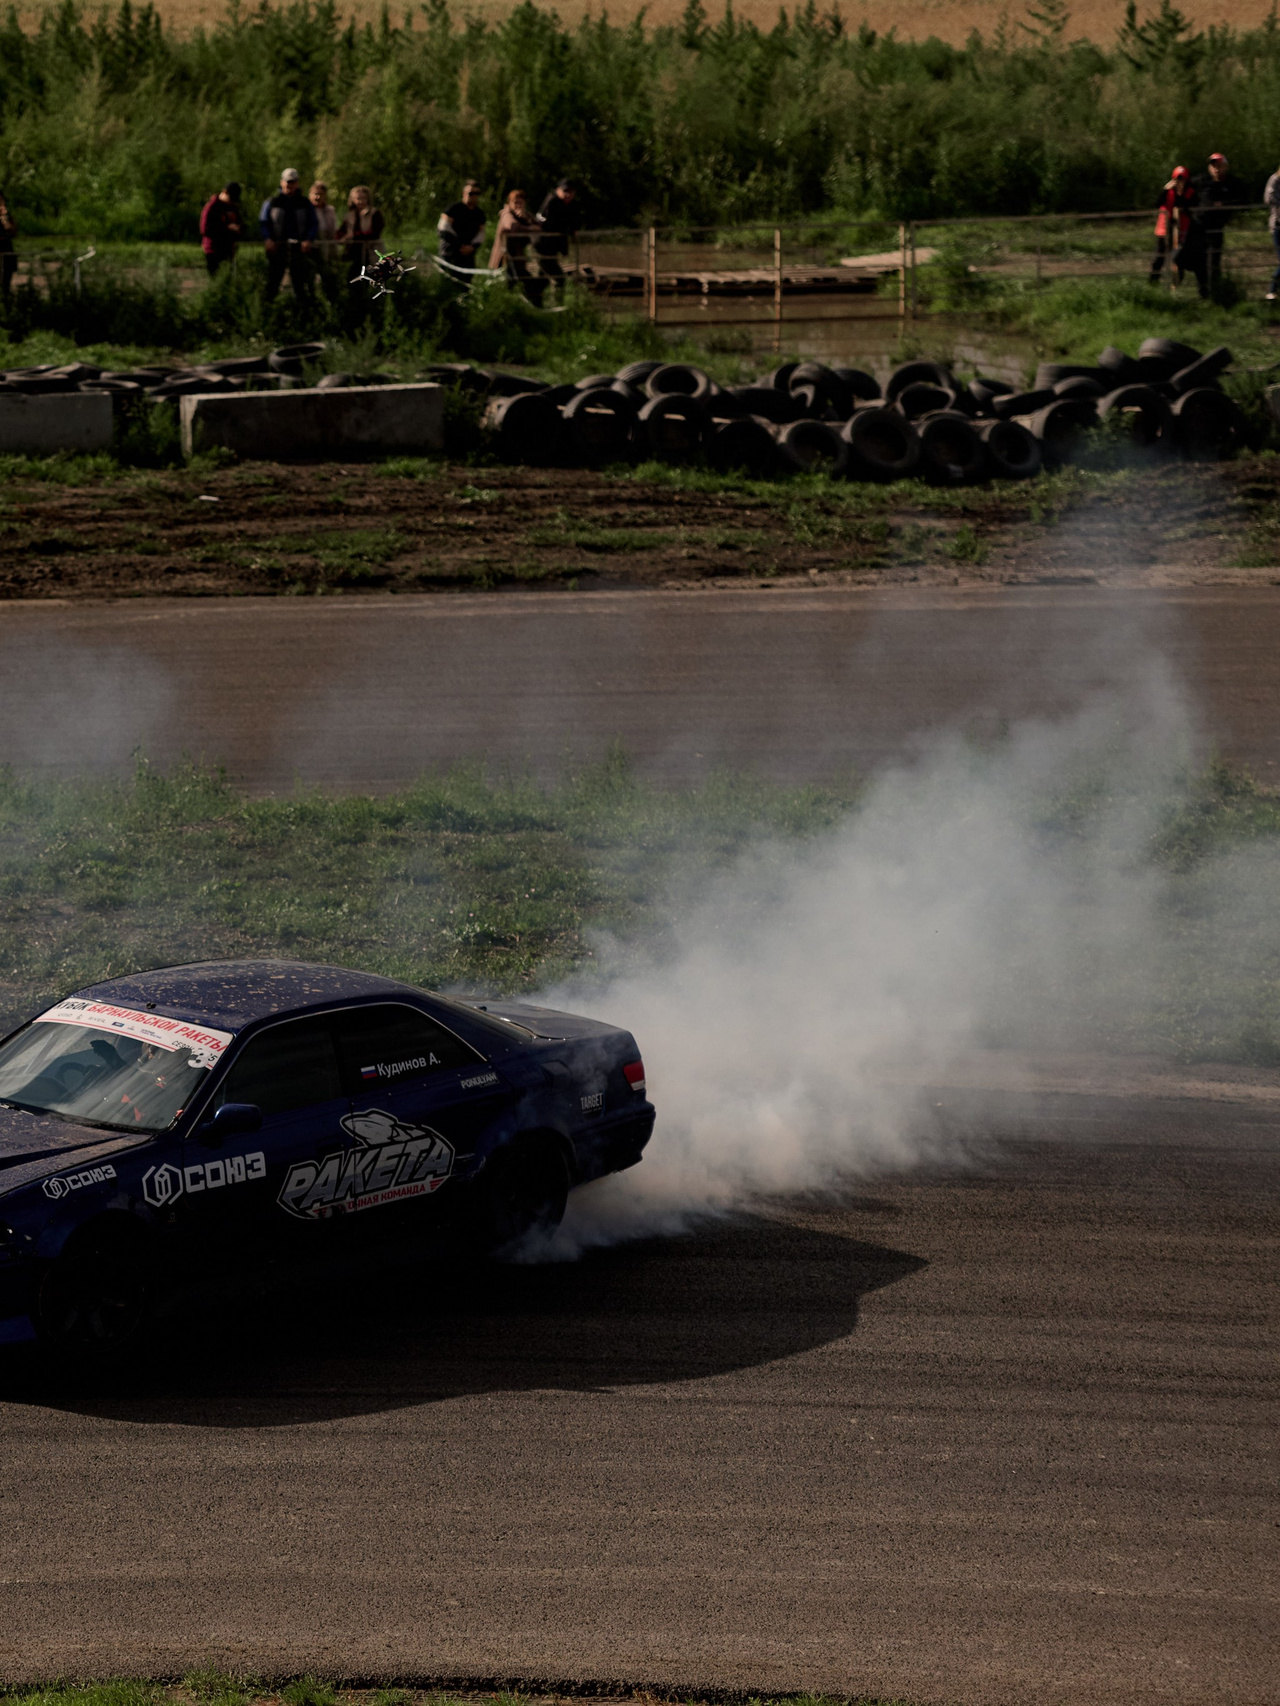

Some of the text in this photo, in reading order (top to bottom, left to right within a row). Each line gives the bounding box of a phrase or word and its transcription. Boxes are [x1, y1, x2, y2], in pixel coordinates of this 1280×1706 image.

[87, 1004, 180, 1031] БАРНАУЛЬСКОЙ
[175, 1026, 229, 1052] РАКЕТЫ
[377, 1052, 441, 1078] Кудинов А.
[580, 1092, 603, 1110] TARGET
[68, 1164, 117, 1190] СОЮЗ
[183, 1151, 267, 1193] СОЮЗ
[282, 1136, 451, 1210] РАКЕТА
[380, 1184, 426, 1201] КОМАНДА
